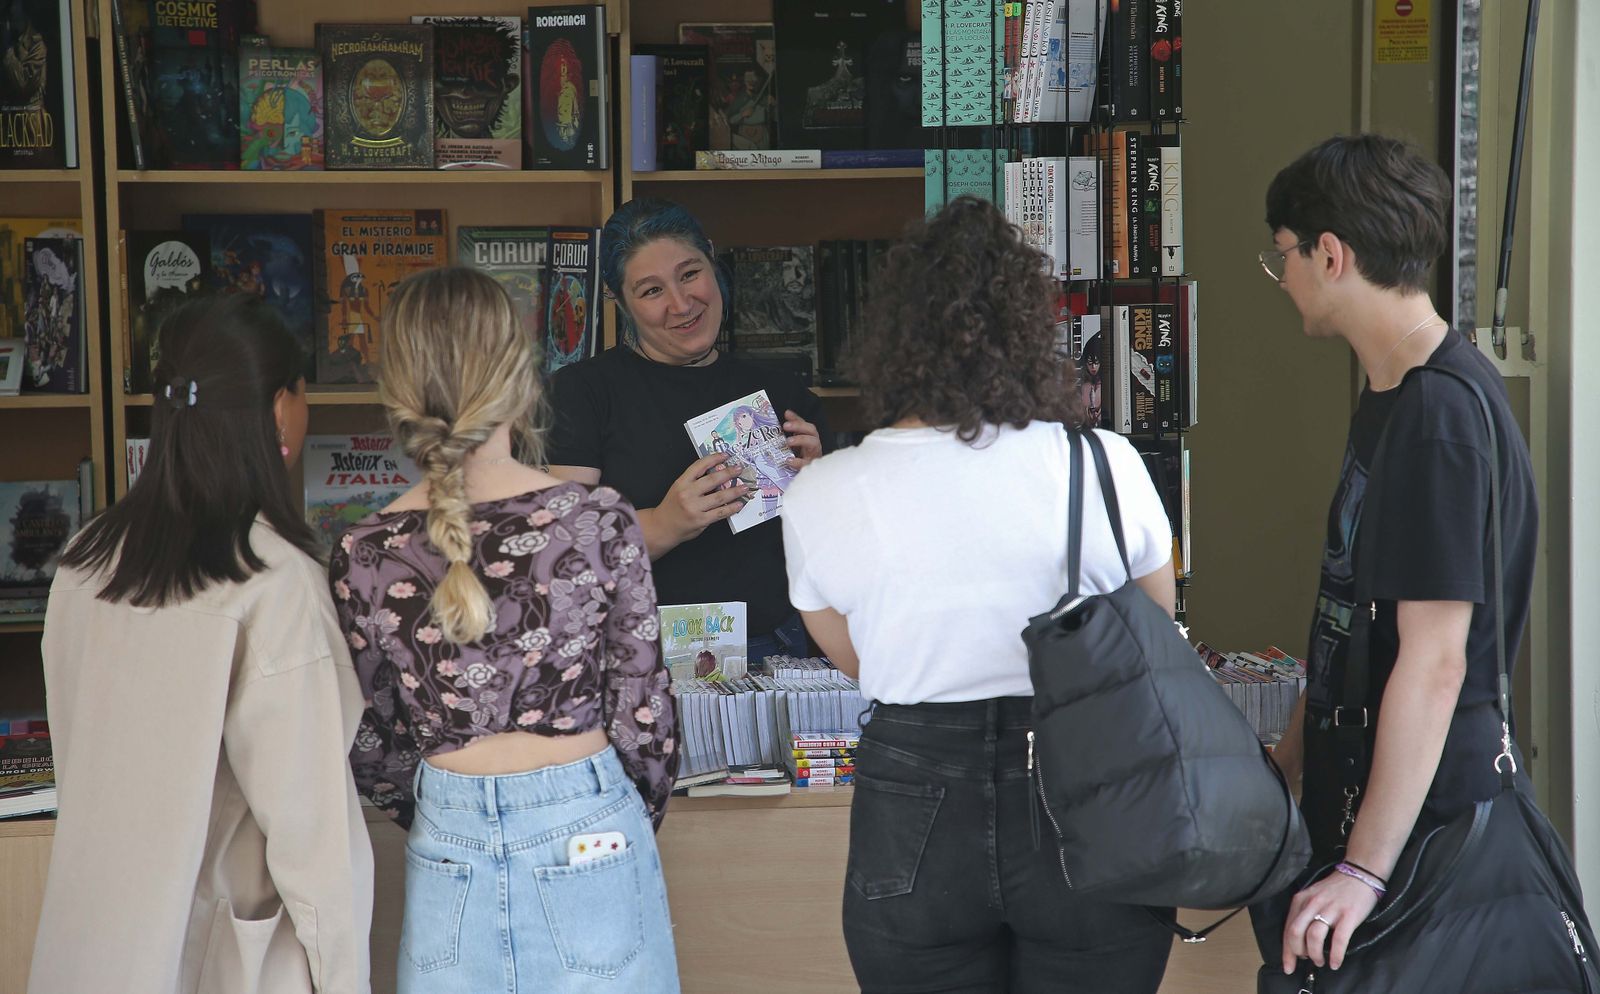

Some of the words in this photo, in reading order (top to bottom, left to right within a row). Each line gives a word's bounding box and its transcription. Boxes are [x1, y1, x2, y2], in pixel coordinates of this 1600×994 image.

[155, 0, 217, 17] COSMIC
[1155, 4, 1168, 33] KING
[1173, 0, 1181, 17] KING
[157, 16, 218, 28] DETECTIVE
[536, 14, 586, 27] RORSCHACH
[248, 59, 315, 71] PERLAS
[0, 112, 54, 148] LACKSAD
[363, 143, 412, 157] LOVECRAFT
[719, 153, 748, 168] Bosque
[750, 152, 782, 166] Mitago
[1147, 163, 1160, 191] KING
[1163, 162, 1178, 212] KING
[343, 226, 354, 236] EL
[359, 226, 412, 237] MISTERIO
[331, 242, 368, 256] GRAN
[474, 242, 547, 264] CORUM
[552, 242, 589, 266] CORUM
[150, 251, 194, 277] Galdós
[1134, 308, 1146, 350] KING
[1144, 308, 1153, 350] STEPHEN
[1158, 320, 1172, 347] KING
[1136, 391, 1145, 421] SUMMERS
[1145, 397, 1154, 414] BILLY
[331, 452, 384, 471] Astérix
[384, 459, 399, 471] EN
[673, 618, 704, 638] LOOK
[705, 615, 735, 633] BACK
